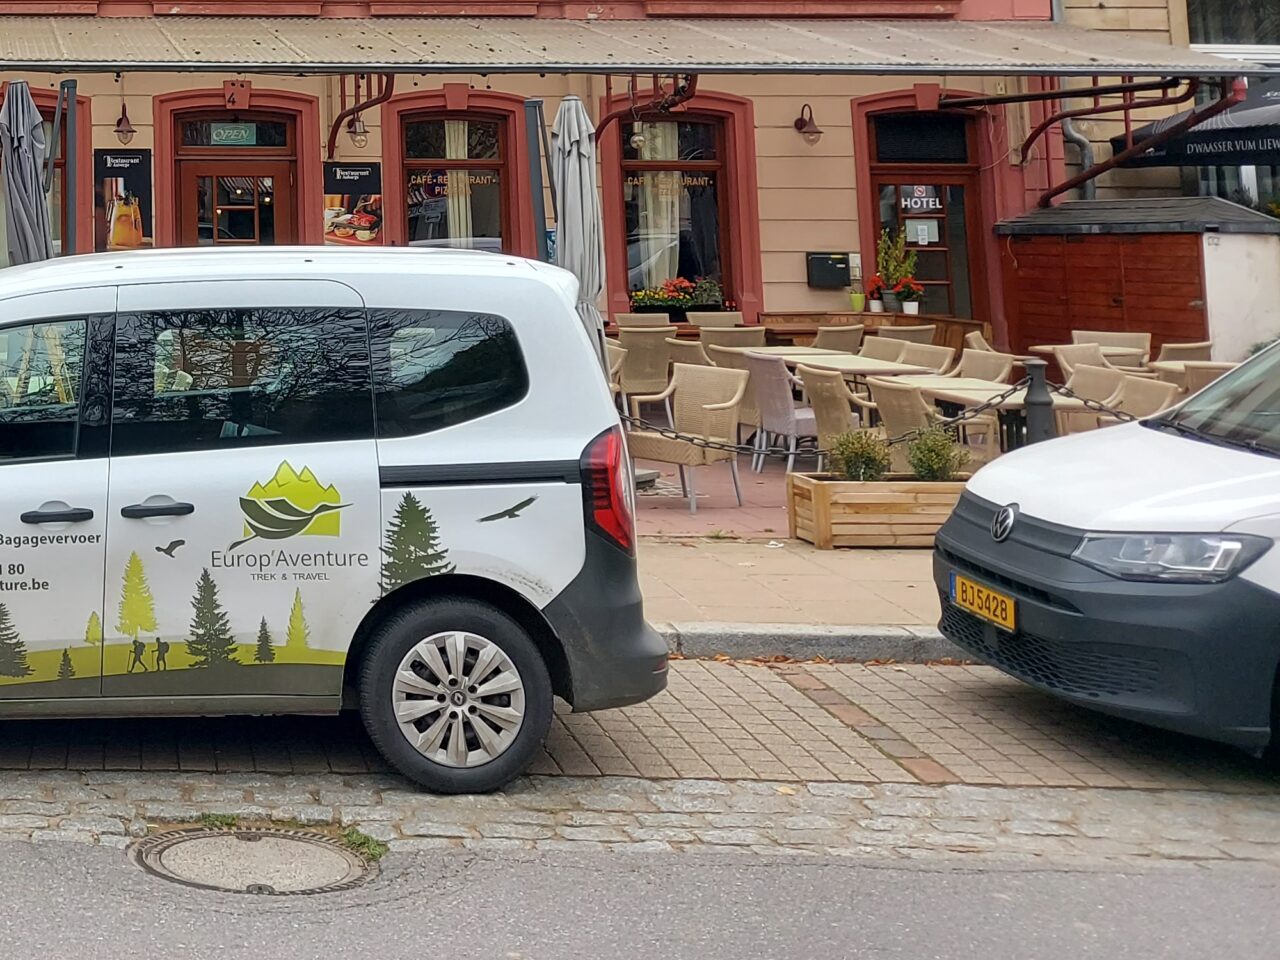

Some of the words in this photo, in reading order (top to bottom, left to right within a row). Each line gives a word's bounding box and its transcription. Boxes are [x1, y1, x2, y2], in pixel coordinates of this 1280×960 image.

[227, 92, 236, 106] 4
[212, 128, 250, 141] OPEN
[1186, 140, 1234, 154] D'WAASSER
[1234, 139, 1257, 151] VUM
[901, 197, 943, 209] HOTEL
[211, 550, 369, 572] Europ'Aventure
[7, 563, 25, 575] 80
[250, 573, 277, 581] TREK
[281, 573, 288, 581] &
[292, 573, 330, 581] TRAVEL
